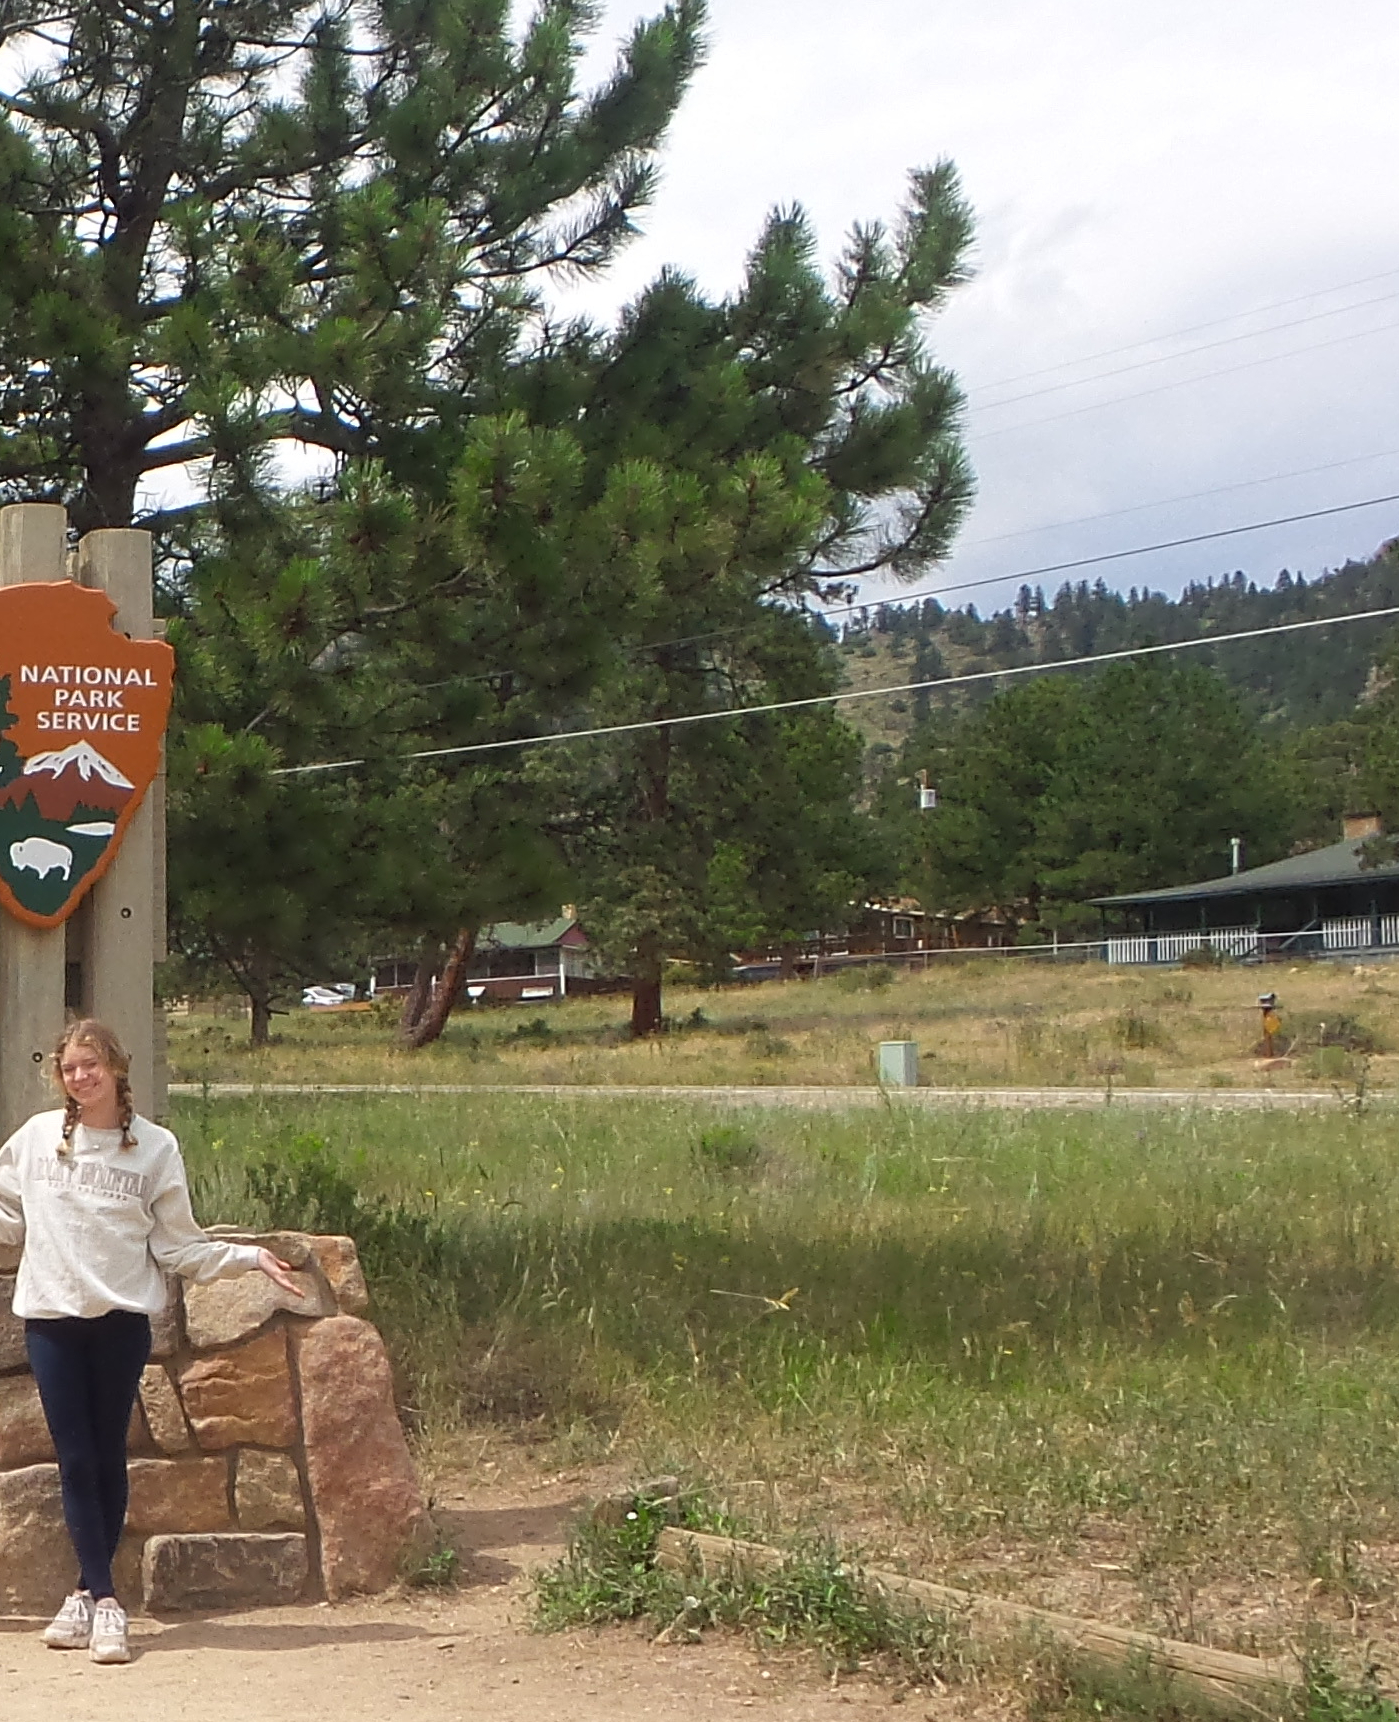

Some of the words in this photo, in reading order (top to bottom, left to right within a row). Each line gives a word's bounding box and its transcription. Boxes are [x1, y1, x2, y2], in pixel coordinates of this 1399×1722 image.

[21, 665, 158, 686] NATIONAL
[54, 689, 123, 708] PARK
[36, 711, 141, 732] SERVICE
